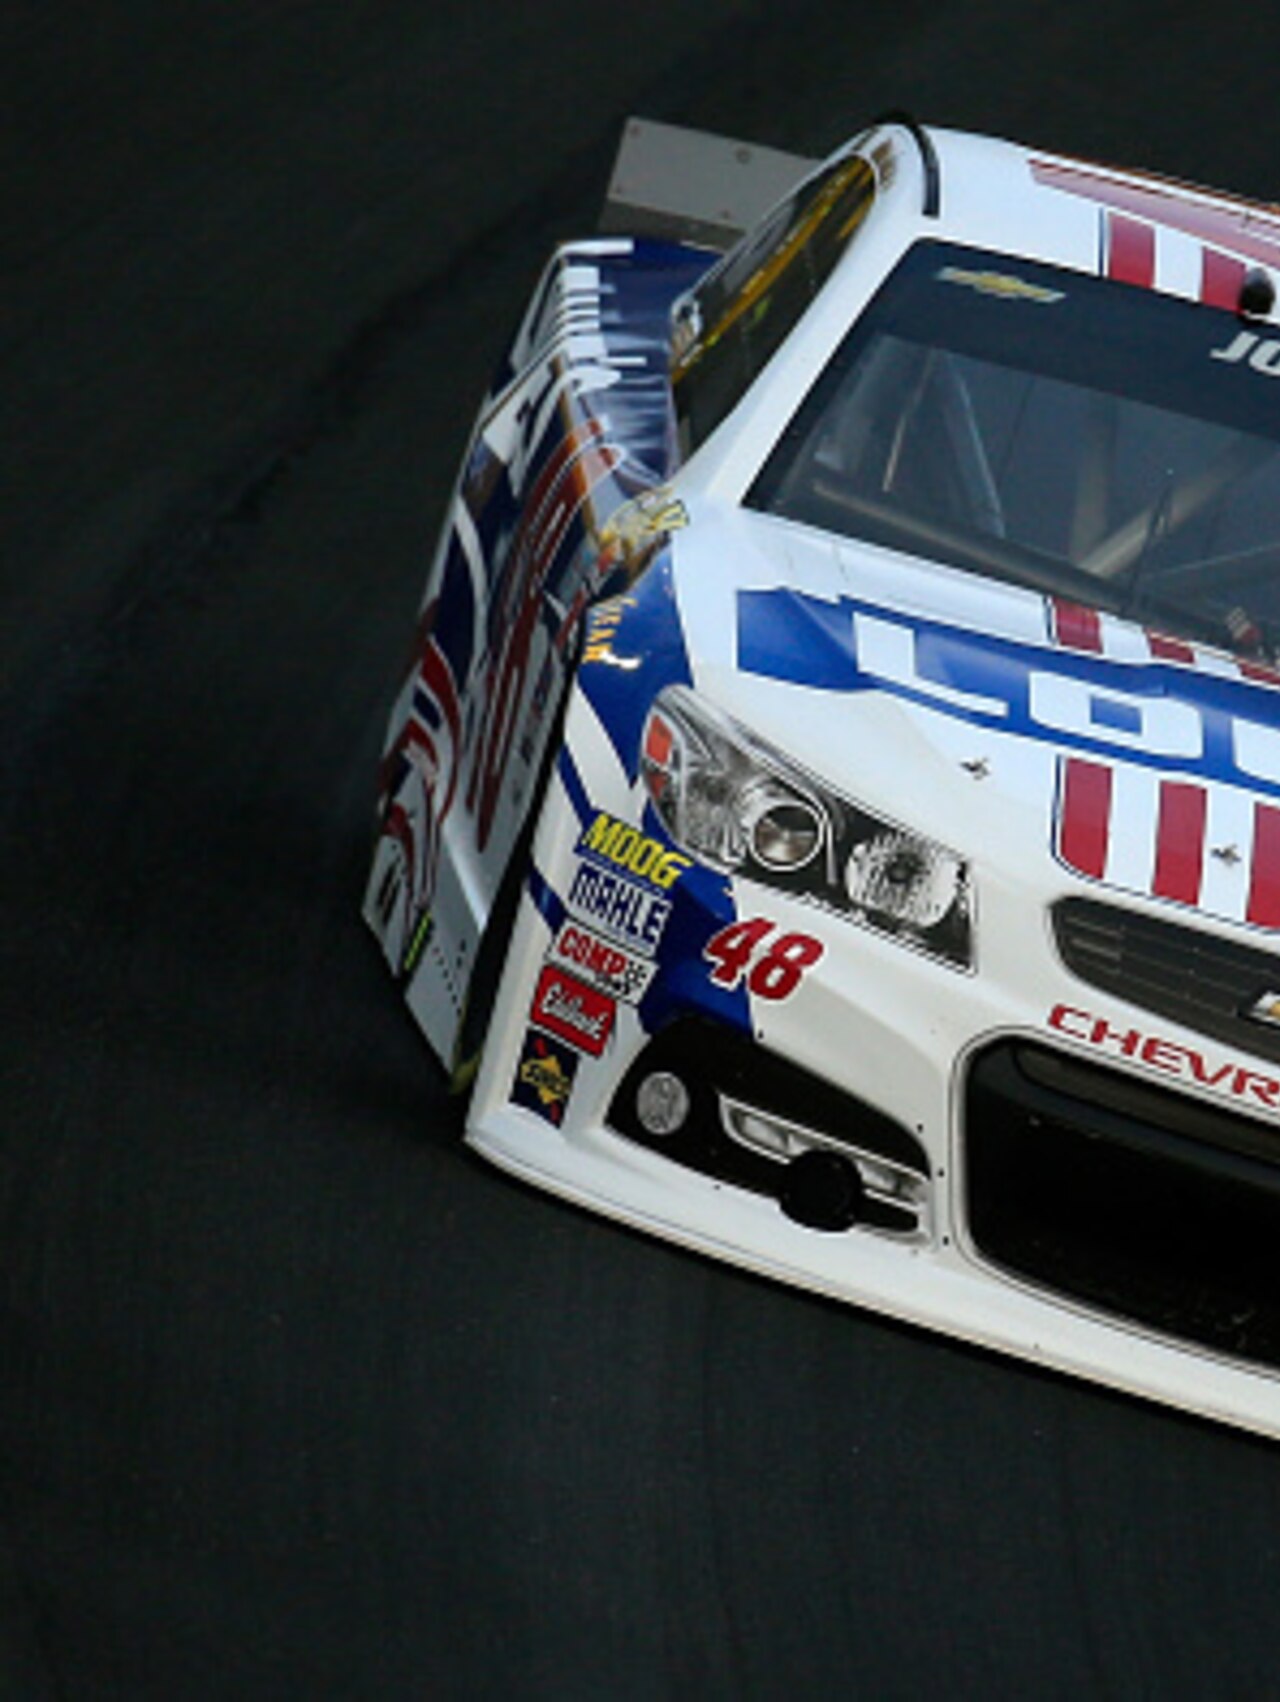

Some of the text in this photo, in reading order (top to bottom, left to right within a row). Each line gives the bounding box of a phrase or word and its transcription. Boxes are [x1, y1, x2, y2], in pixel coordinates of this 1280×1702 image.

[580, 813, 693, 889] MOOG
[568, 863, 672, 945] MAHLE
[704, 916, 824, 1002] 48
